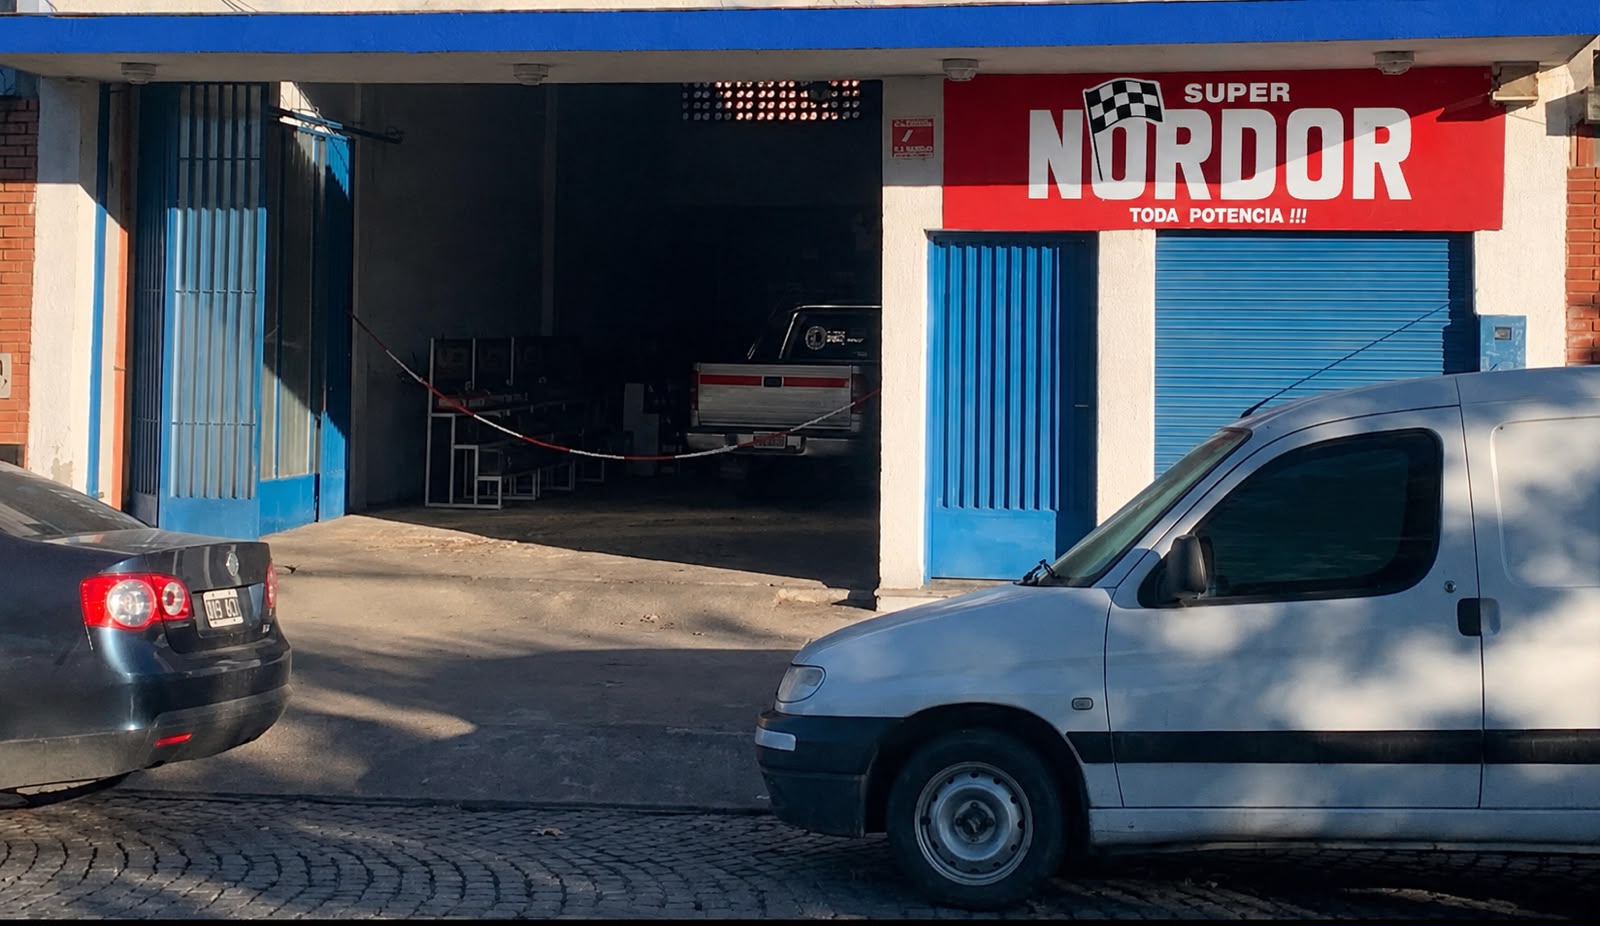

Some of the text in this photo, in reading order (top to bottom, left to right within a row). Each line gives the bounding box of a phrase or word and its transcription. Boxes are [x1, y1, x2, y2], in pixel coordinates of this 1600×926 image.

[1184, 82, 1291, 104] SUPER
[1028, 108, 1412, 201] NORDOR
[1129, 207, 1308, 223] TODA POTENCIA !!!
